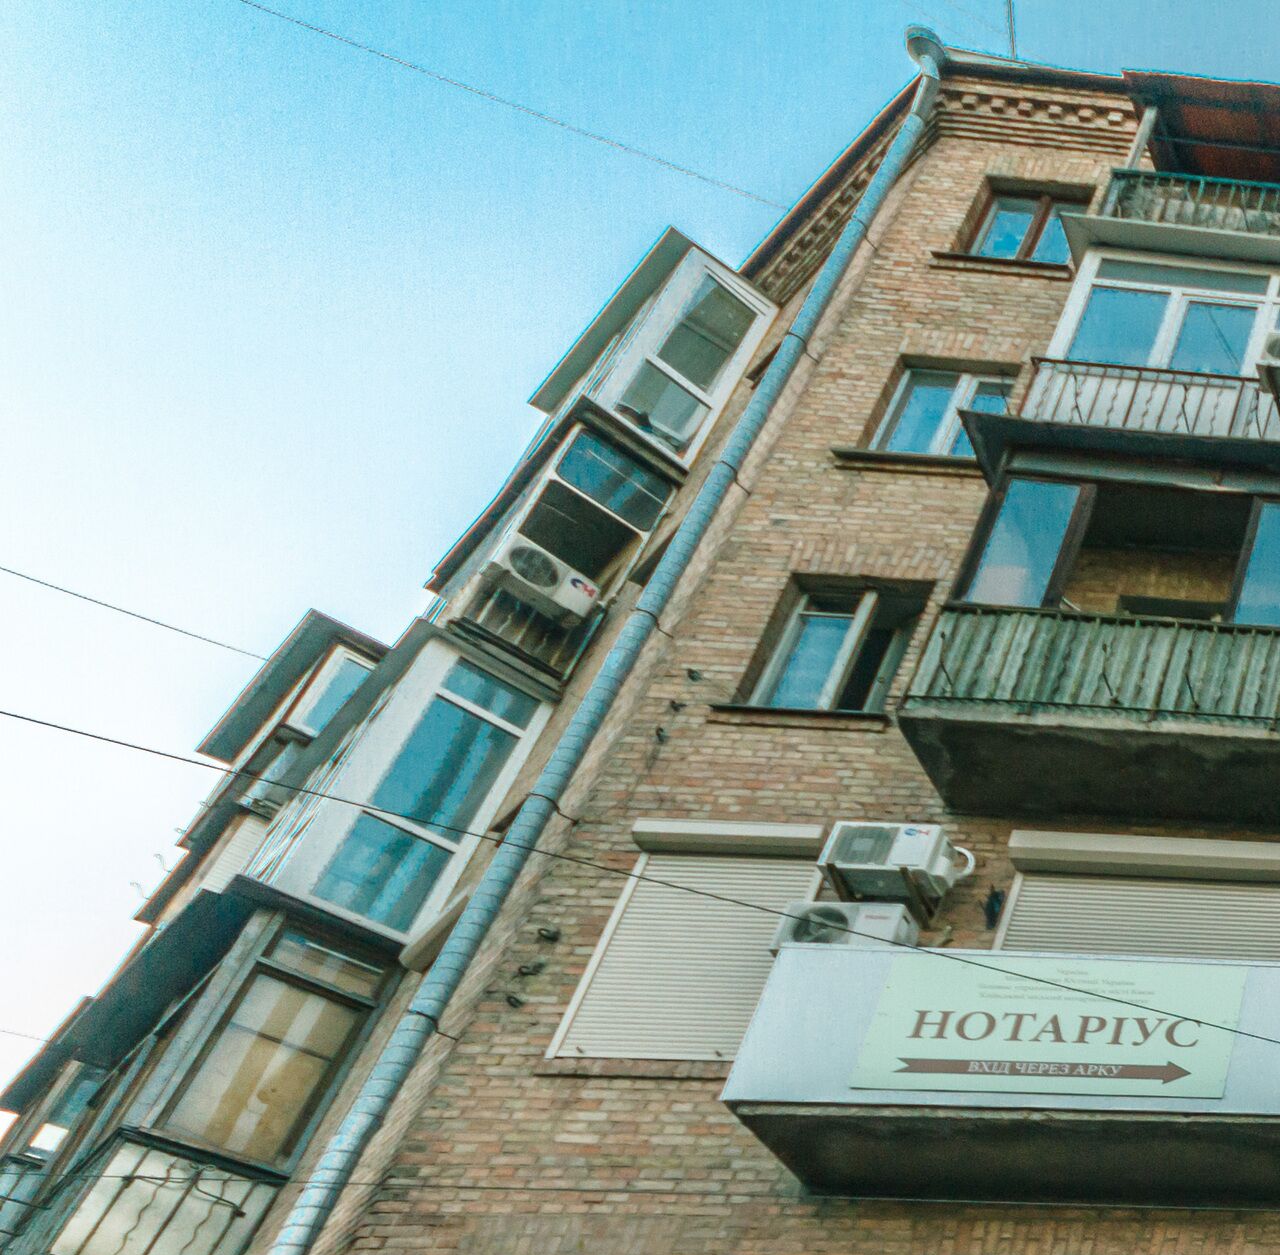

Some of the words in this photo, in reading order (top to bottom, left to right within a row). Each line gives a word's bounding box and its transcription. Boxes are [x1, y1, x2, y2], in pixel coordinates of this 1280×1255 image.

[906, 1009, 1200, 1048] НОТАРІУС
[967, 1060, 1010, 1074] ВХІД
[1014, 1061, 1069, 1075] ЧЕРЕЗ
[1070, 1064, 1123, 1077] АРКУ
